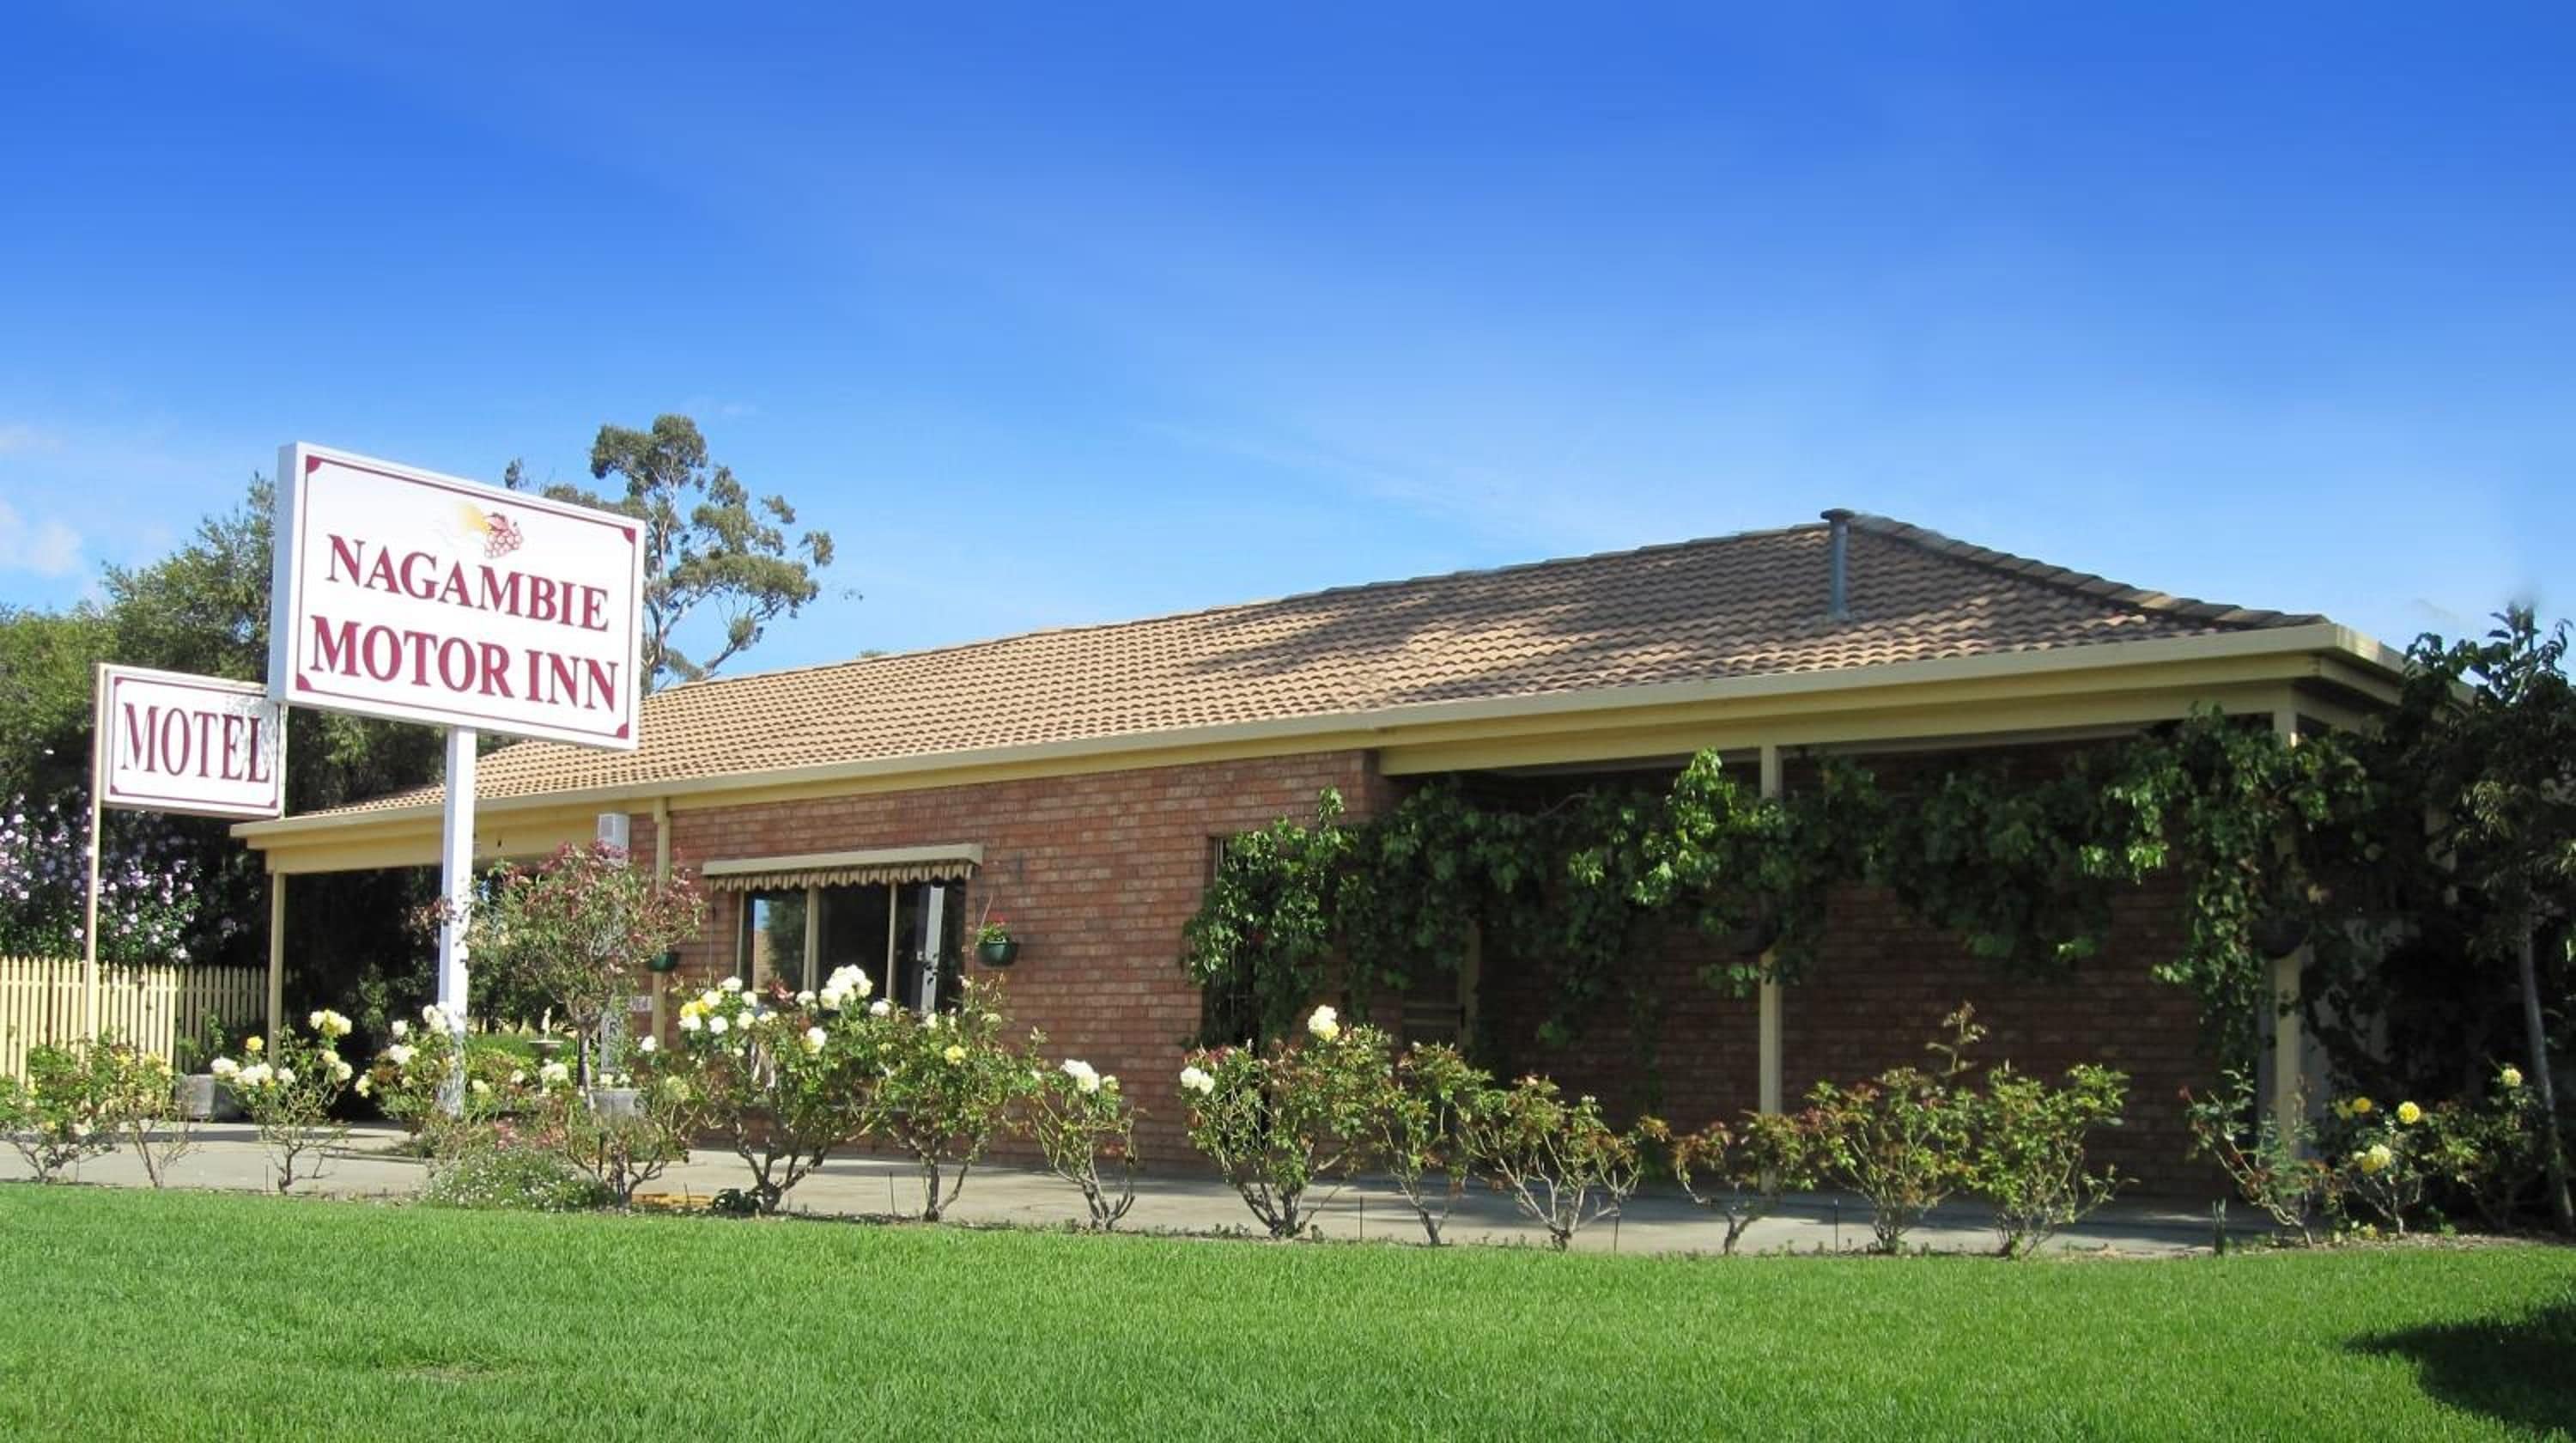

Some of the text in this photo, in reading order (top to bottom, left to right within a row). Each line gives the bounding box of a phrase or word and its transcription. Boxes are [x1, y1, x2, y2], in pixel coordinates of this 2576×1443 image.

[326, 534, 609, 632] NAGAMBIE
[309, 615, 619, 713] MOTOR INN
[121, 703, 270, 784] MOTEL
